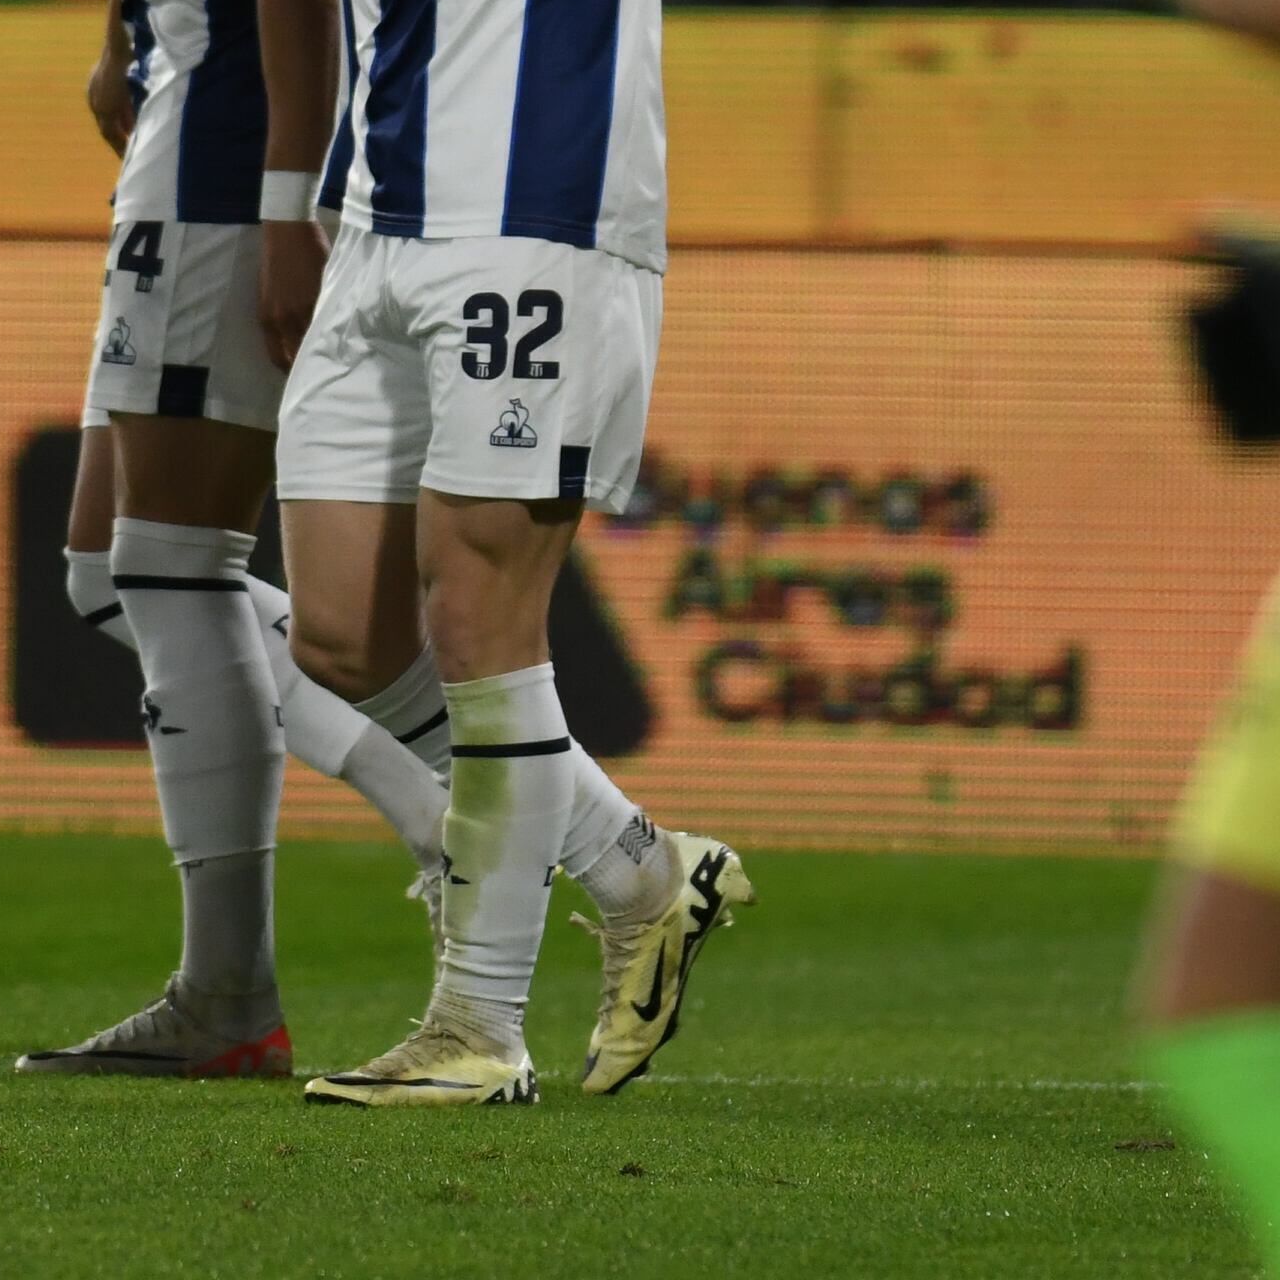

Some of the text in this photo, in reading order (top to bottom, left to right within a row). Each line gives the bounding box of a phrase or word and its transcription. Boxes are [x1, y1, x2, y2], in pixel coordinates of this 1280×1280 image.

[105, 221, 165, 293] 4
[461, 289, 564, 380] 32
[694, 636, 1088, 730] Ciudad
